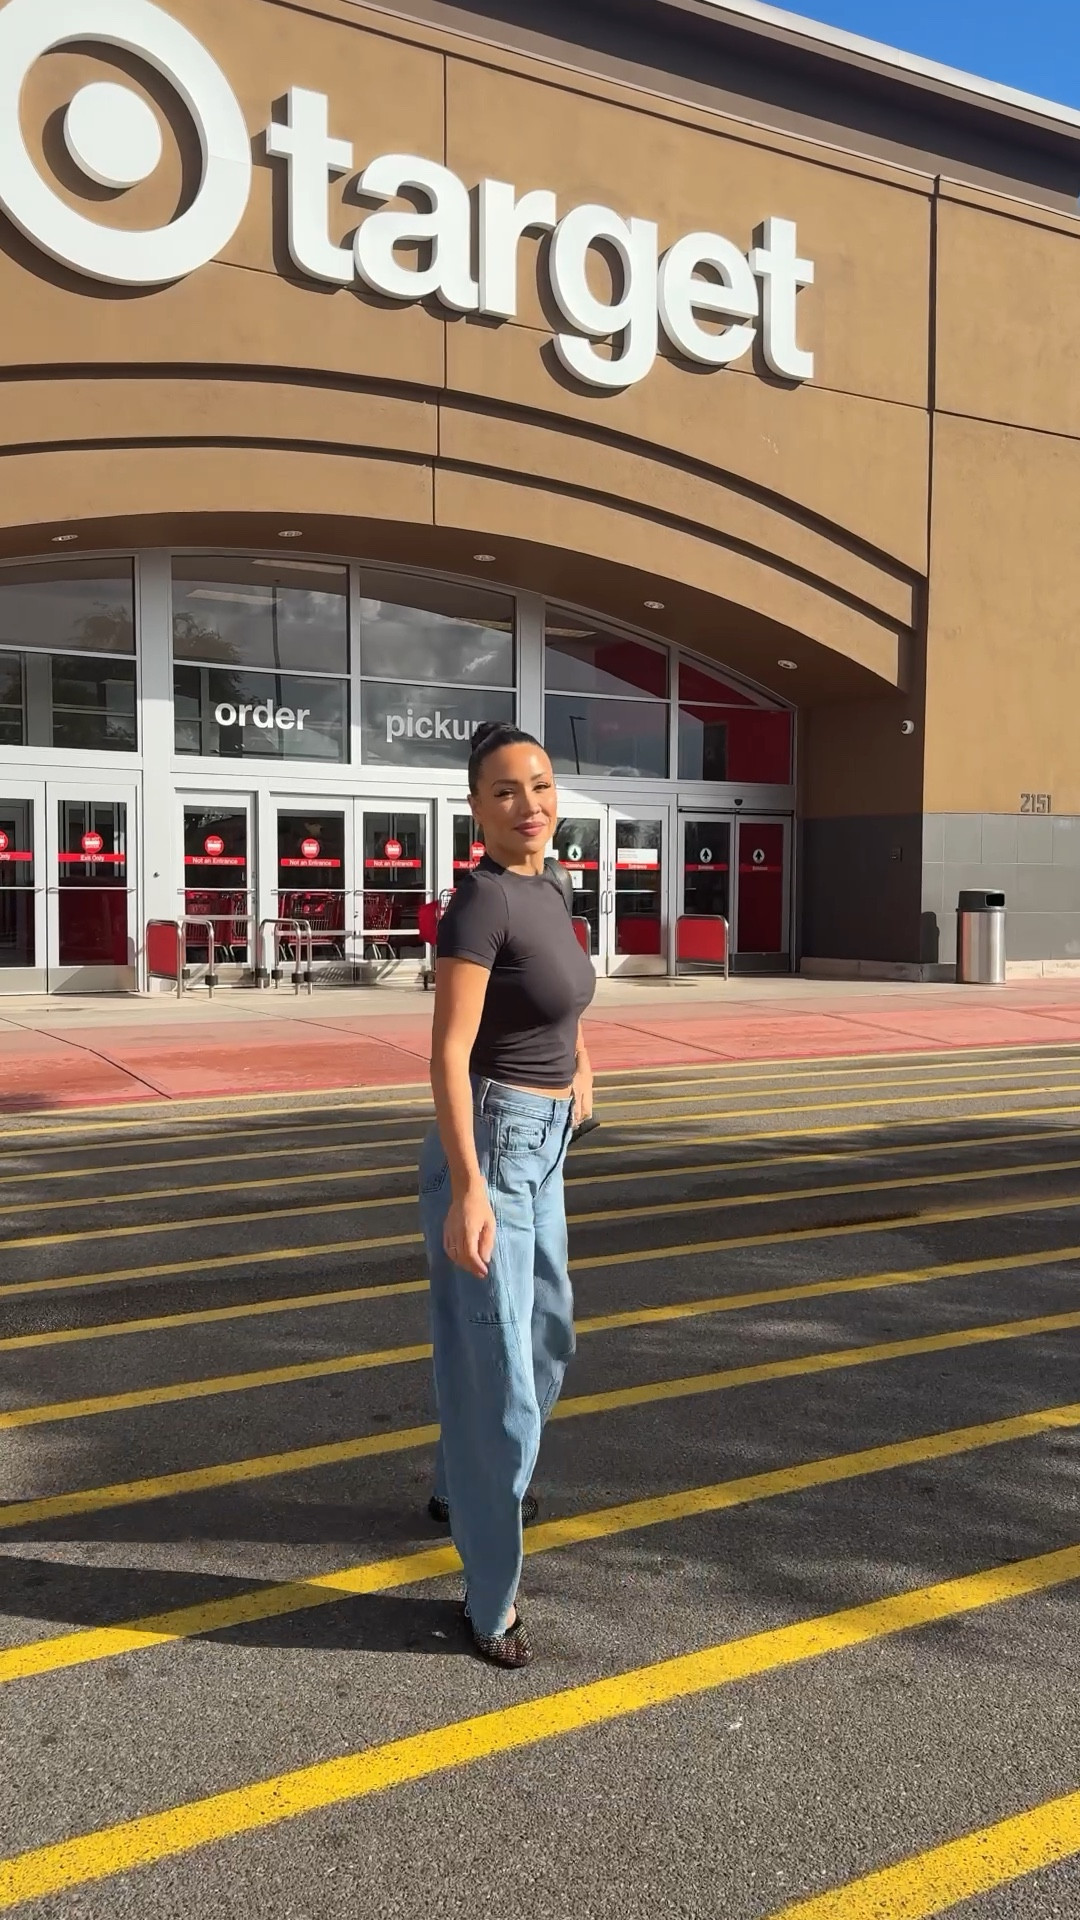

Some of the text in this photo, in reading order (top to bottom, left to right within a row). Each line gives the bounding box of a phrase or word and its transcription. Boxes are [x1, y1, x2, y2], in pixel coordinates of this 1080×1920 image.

[266, 86, 814, 388] target
[215, 699, 310, 730] order
[1020, 793, 1052, 814] 2151
[92, 854, 105, 862] Only
[192, 857, 202, 865] Not
